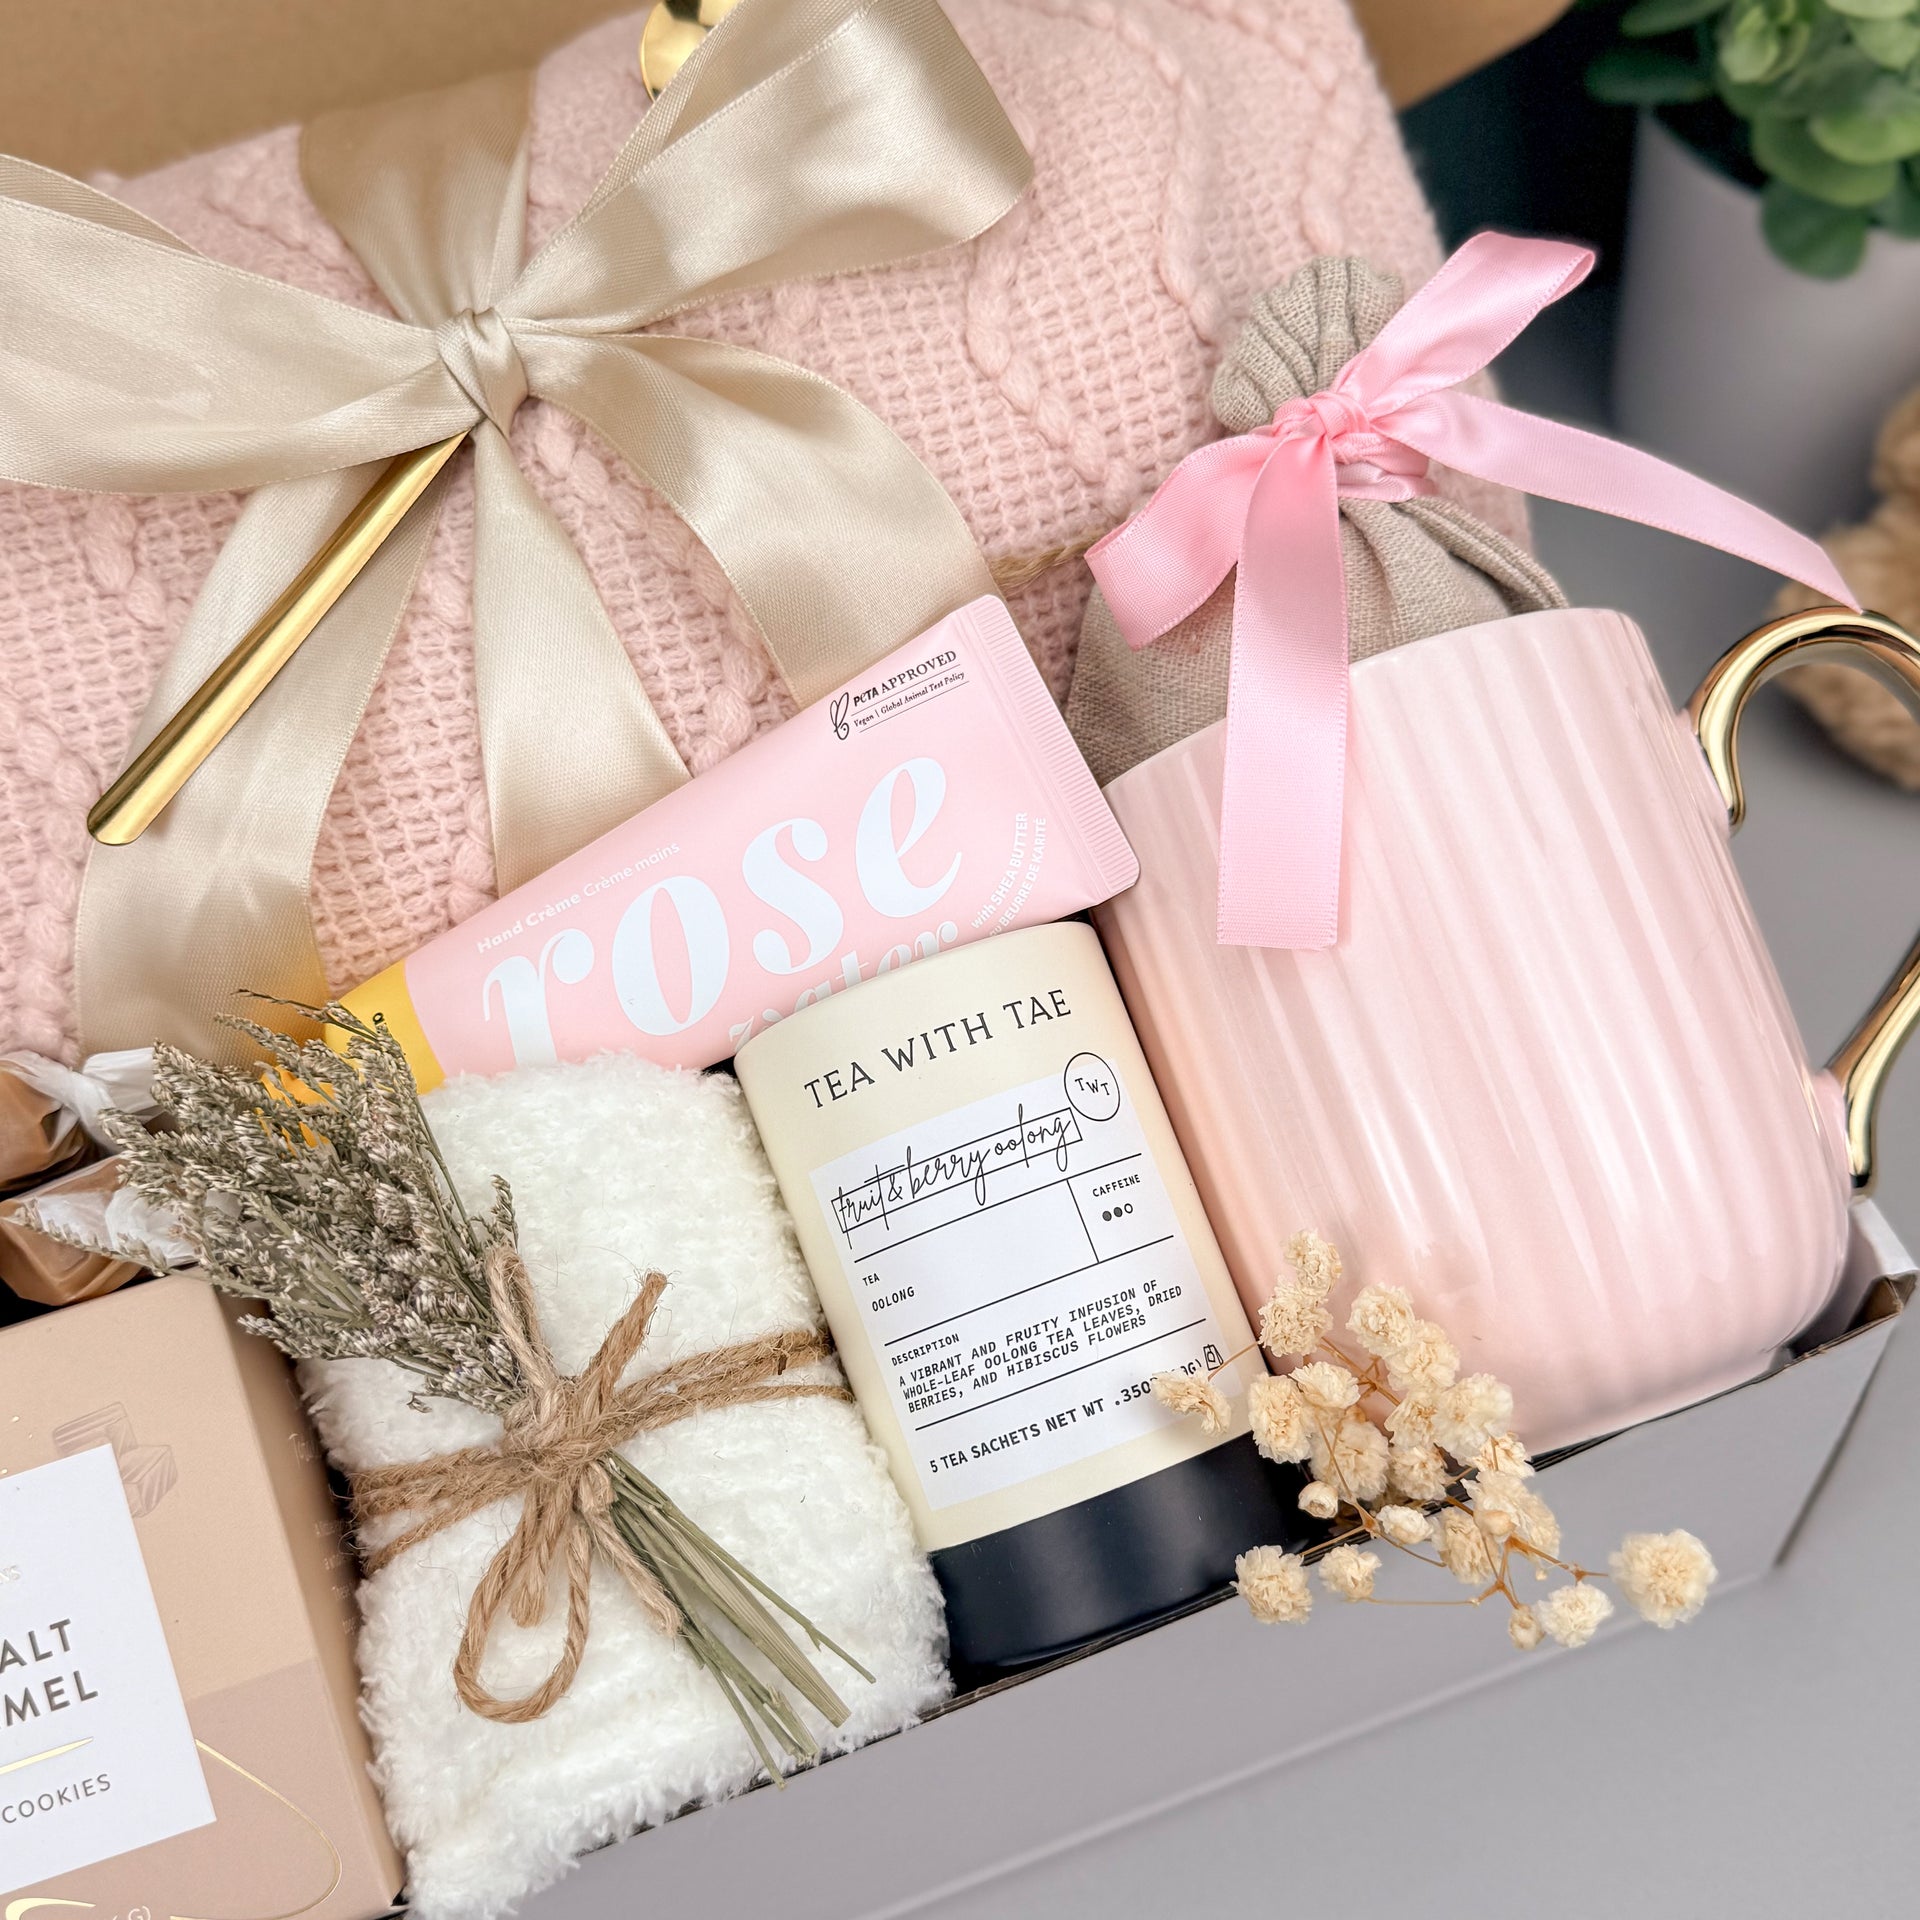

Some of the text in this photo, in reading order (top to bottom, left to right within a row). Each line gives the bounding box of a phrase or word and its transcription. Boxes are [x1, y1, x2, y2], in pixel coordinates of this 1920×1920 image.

[853, 671, 965, 727] Vegan Global Animal Test Policy
[881, 650, 957, 694] APPROVED
[477, 842, 680, 954] Hand Crème Crème mains
[971, 811, 1028, 929] with SHEA BUTTER
[998, 881, 1033, 927] BEURRE
[1025, 864, 1040, 881] DE
[483, 757, 962, 1066] rose
[804, 989, 1072, 1109] TEA WITH TAE
[1074, 1077, 1110, 1096] TWT
[994, 1103, 1072, 1172] oolong
[1092, 1174, 1141, 1197] CAFFEINE
[862, 1273, 881, 1287] TEA
[871, 1286, 916, 1312] OOLONG
[892, 1334, 960, 1366] DESCRIPTION
[899, 1280, 1157, 1387] A VIBRANT AND FRUITY INFUSION OF
[903, 1285, 1182, 1400] WHOLE-LEAF OOLONG TEA LEAVES, DRIED
[908, 1314, 1147, 1413] BERRIES, AND HIBISCUS FLOWERS
[929, 1460, 938, 1473] 5
[940, 1451, 968, 1470] TEA
[971, 1423, 1041, 1459] SACHETS
[1045, 1409, 1077, 1432] NET
[1082, 1398, 1104, 1418] WT
[0, 1618, 71, 1673] ALT
[0, 1670, 98, 1728] MEL
[1, 1773, 112, 1824] COOKIES
